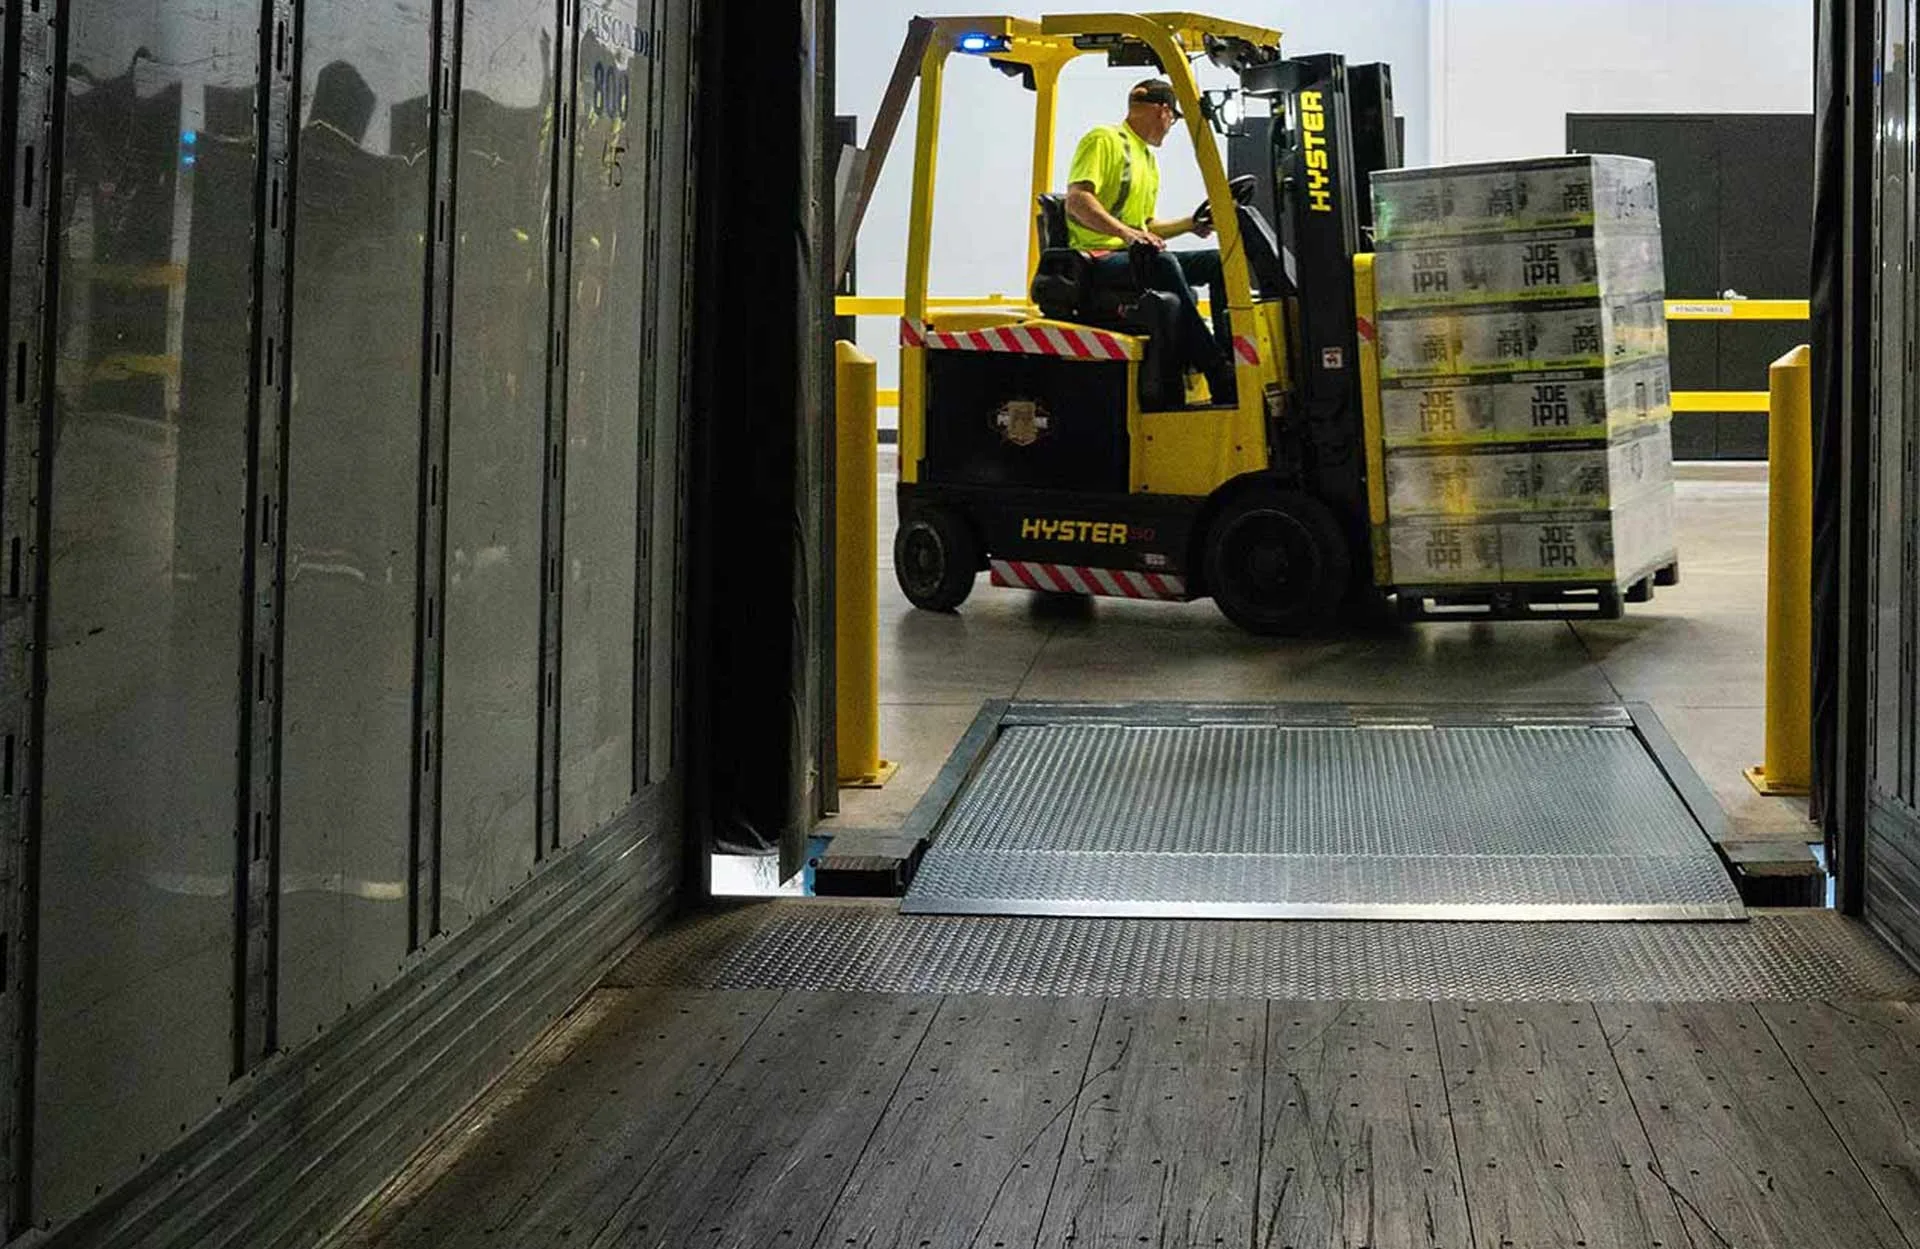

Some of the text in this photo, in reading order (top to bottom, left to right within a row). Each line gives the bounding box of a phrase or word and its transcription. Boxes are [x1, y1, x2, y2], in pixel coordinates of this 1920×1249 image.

[1300, 89, 1332, 213] HYSTER
[1412, 251, 1446, 270] JOE
[1521, 243, 1559, 263] JOE
[1412, 271, 1449, 293] IPA
[1522, 263, 1561, 287] IPA
[1572, 338, 1599, 354] IPA
[1419, 390, 1455, 409] JOE
[1530, 384, 1567, 403] JOE
[1419, 409, 1456, 433] IPA
[1531, 403, 1570, 427] IPA
[1021, 518, 1128, 544] HYSTER
[1426, 528, 1461, 547] JOE
[1539, 525, 1575, 544] JOE
[1426, 547, 1463, 570] IPA
[1539, 544, 1578, 568] IPA
